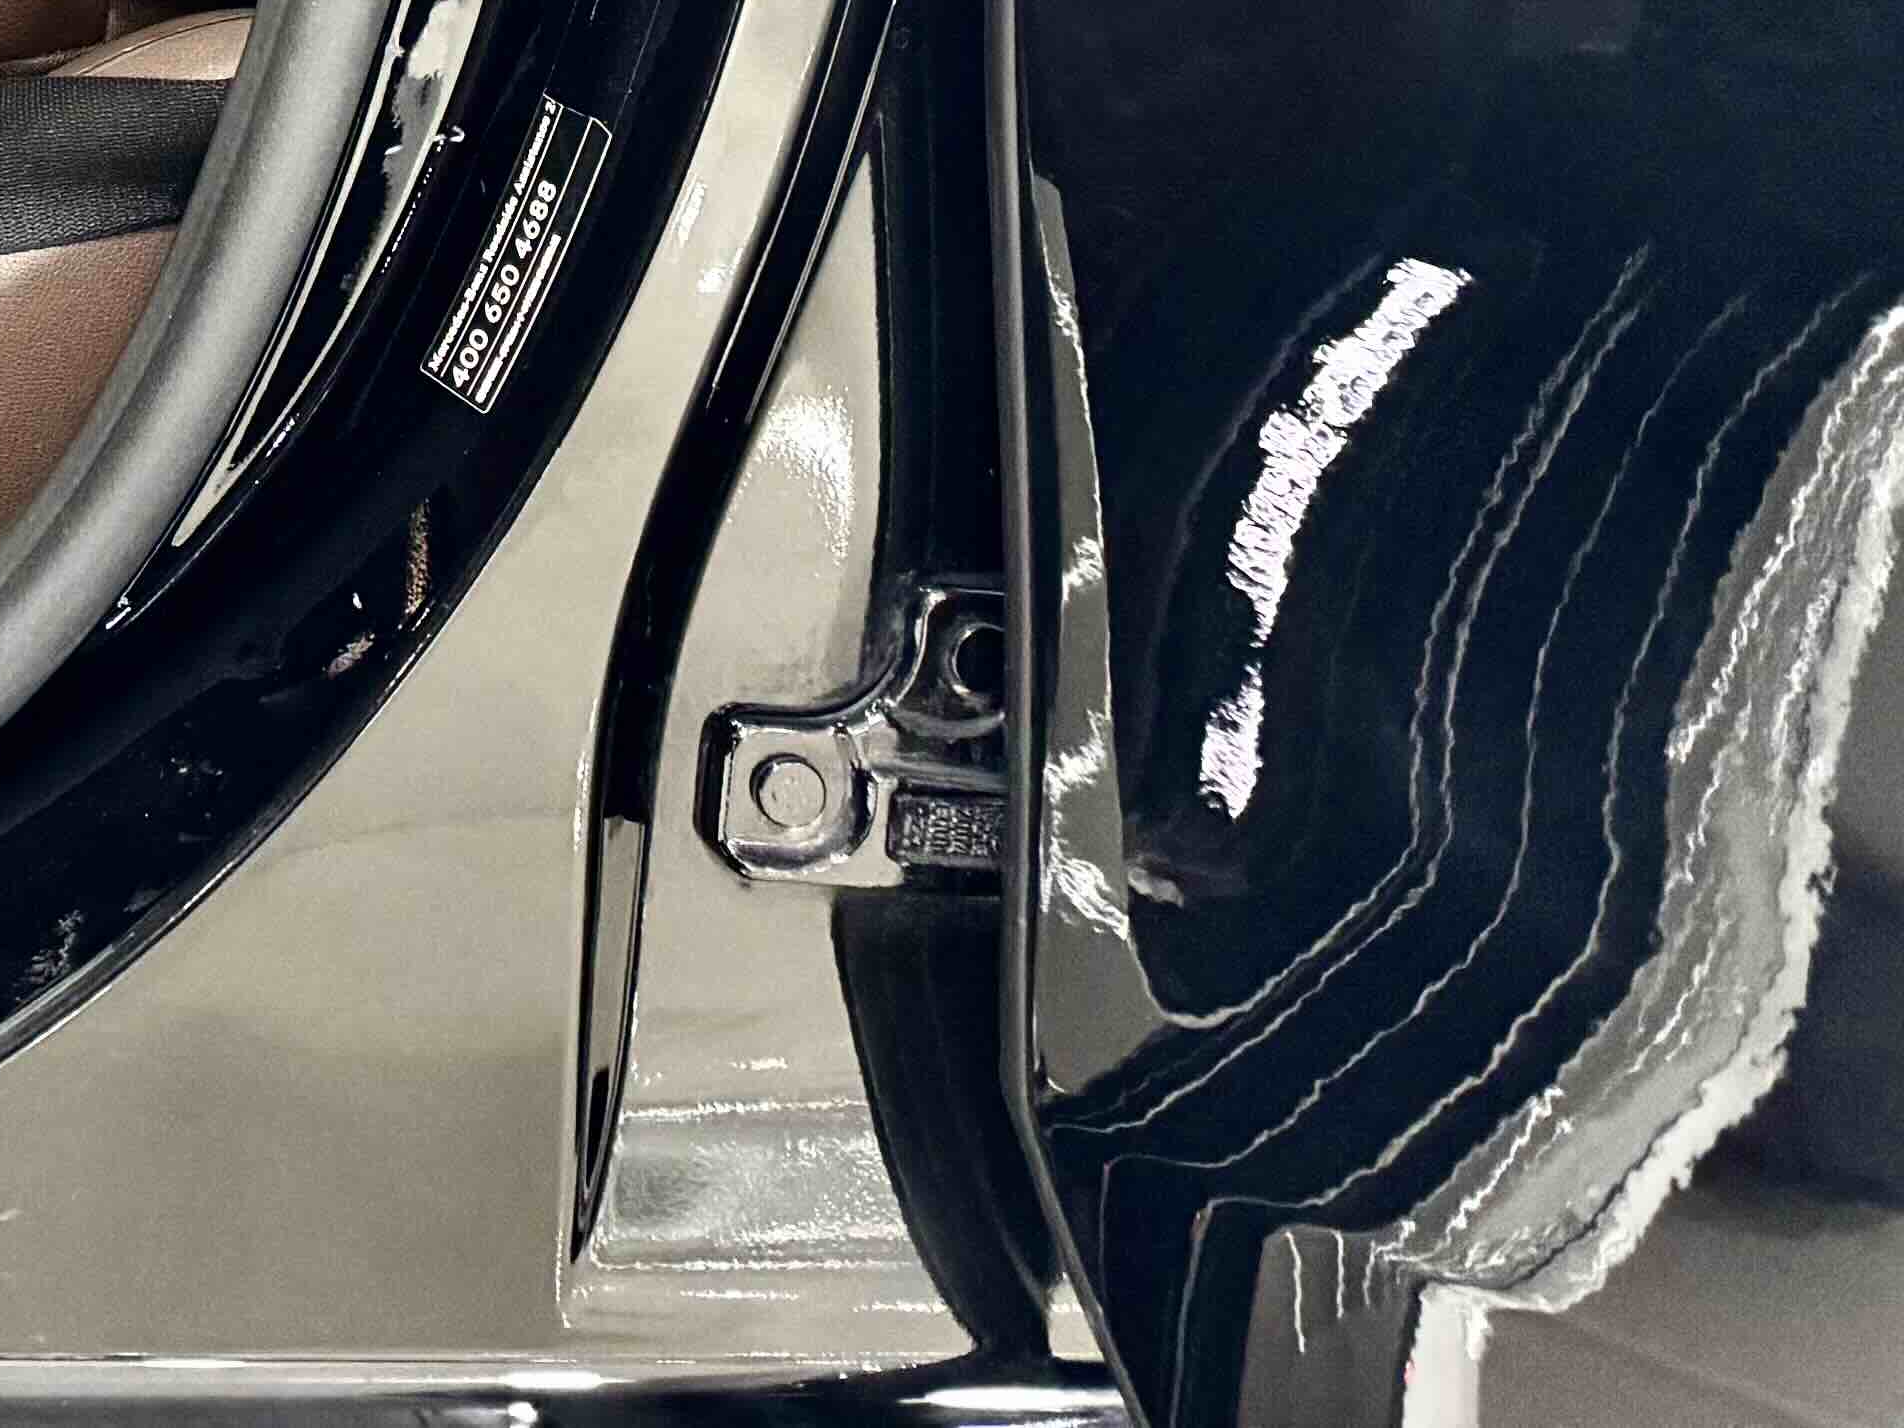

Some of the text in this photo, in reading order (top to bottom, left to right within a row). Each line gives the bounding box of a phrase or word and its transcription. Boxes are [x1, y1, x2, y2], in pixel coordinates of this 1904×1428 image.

[453, 329, 489, 388] 400
[485, 264, 520, 324] 650
[515, 180, 557, 260] 4688
